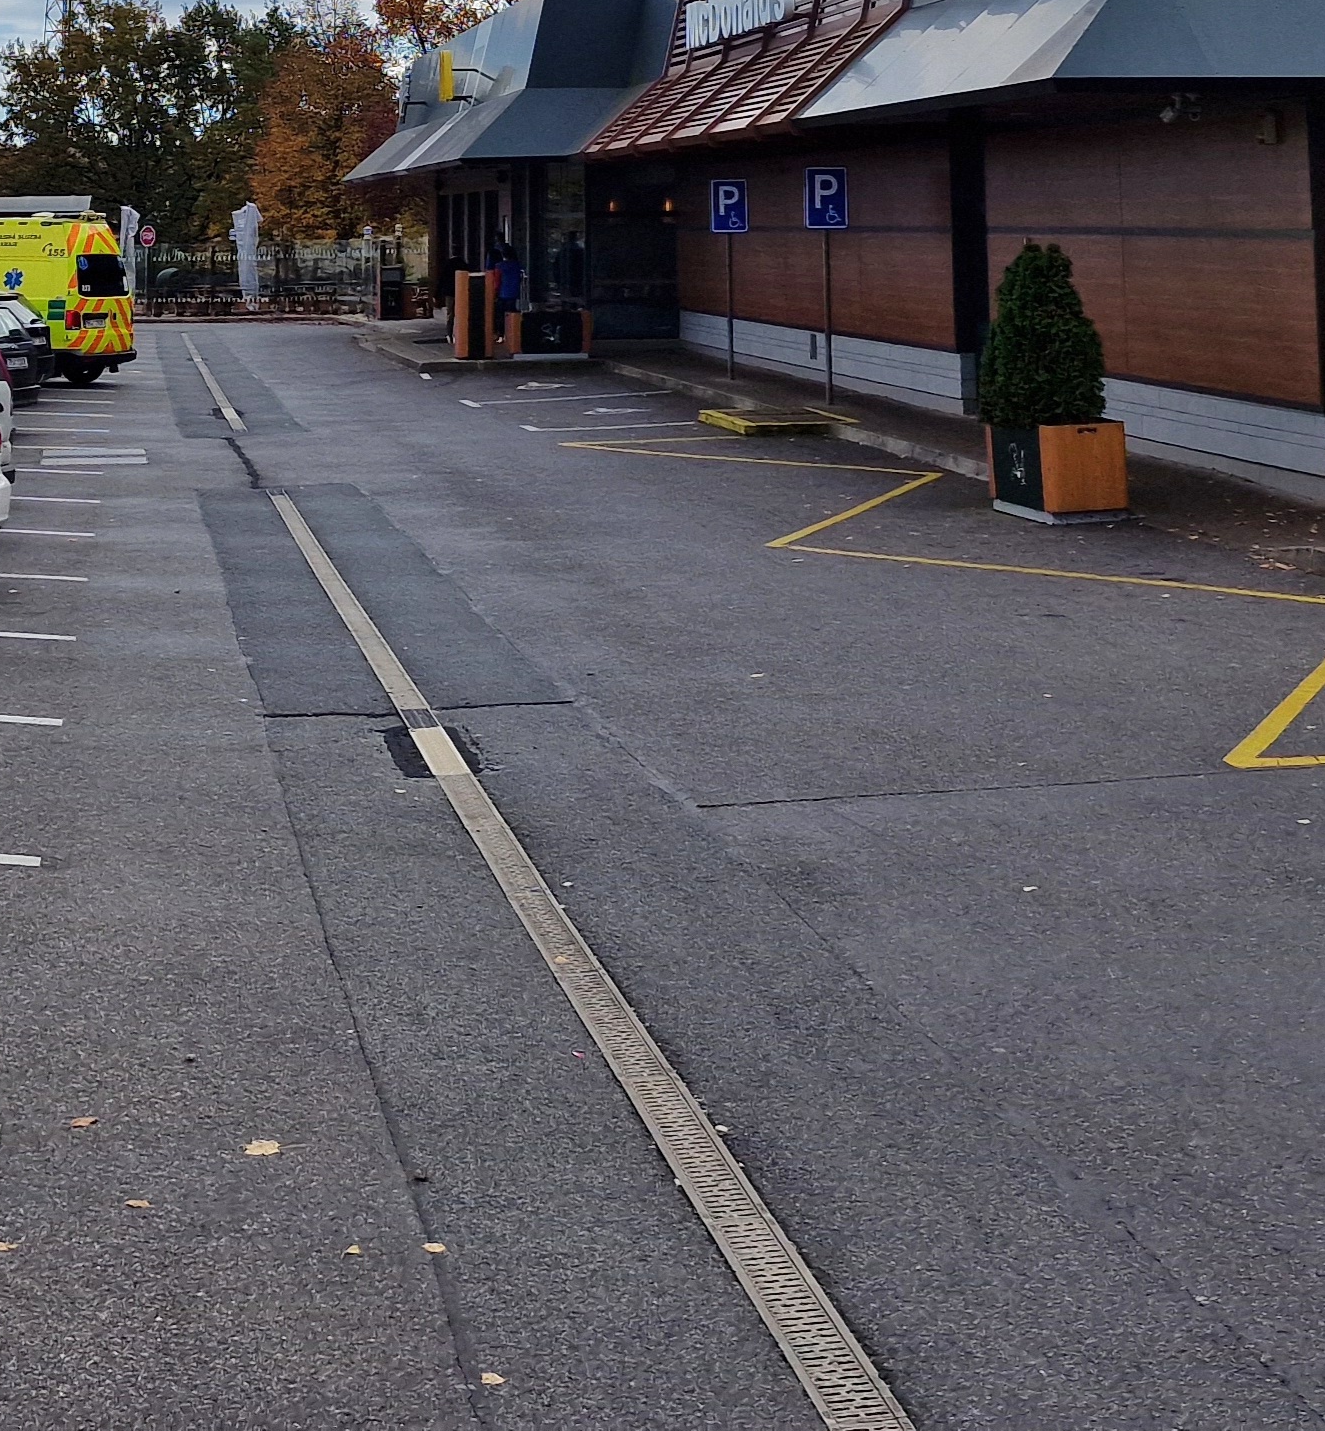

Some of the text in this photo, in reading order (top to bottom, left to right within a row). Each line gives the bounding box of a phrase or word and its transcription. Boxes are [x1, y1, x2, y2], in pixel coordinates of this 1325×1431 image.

[719, 185, 740, 216] P
[814, 174, 838, 209] P
[47, 248, 66, 257] 155
